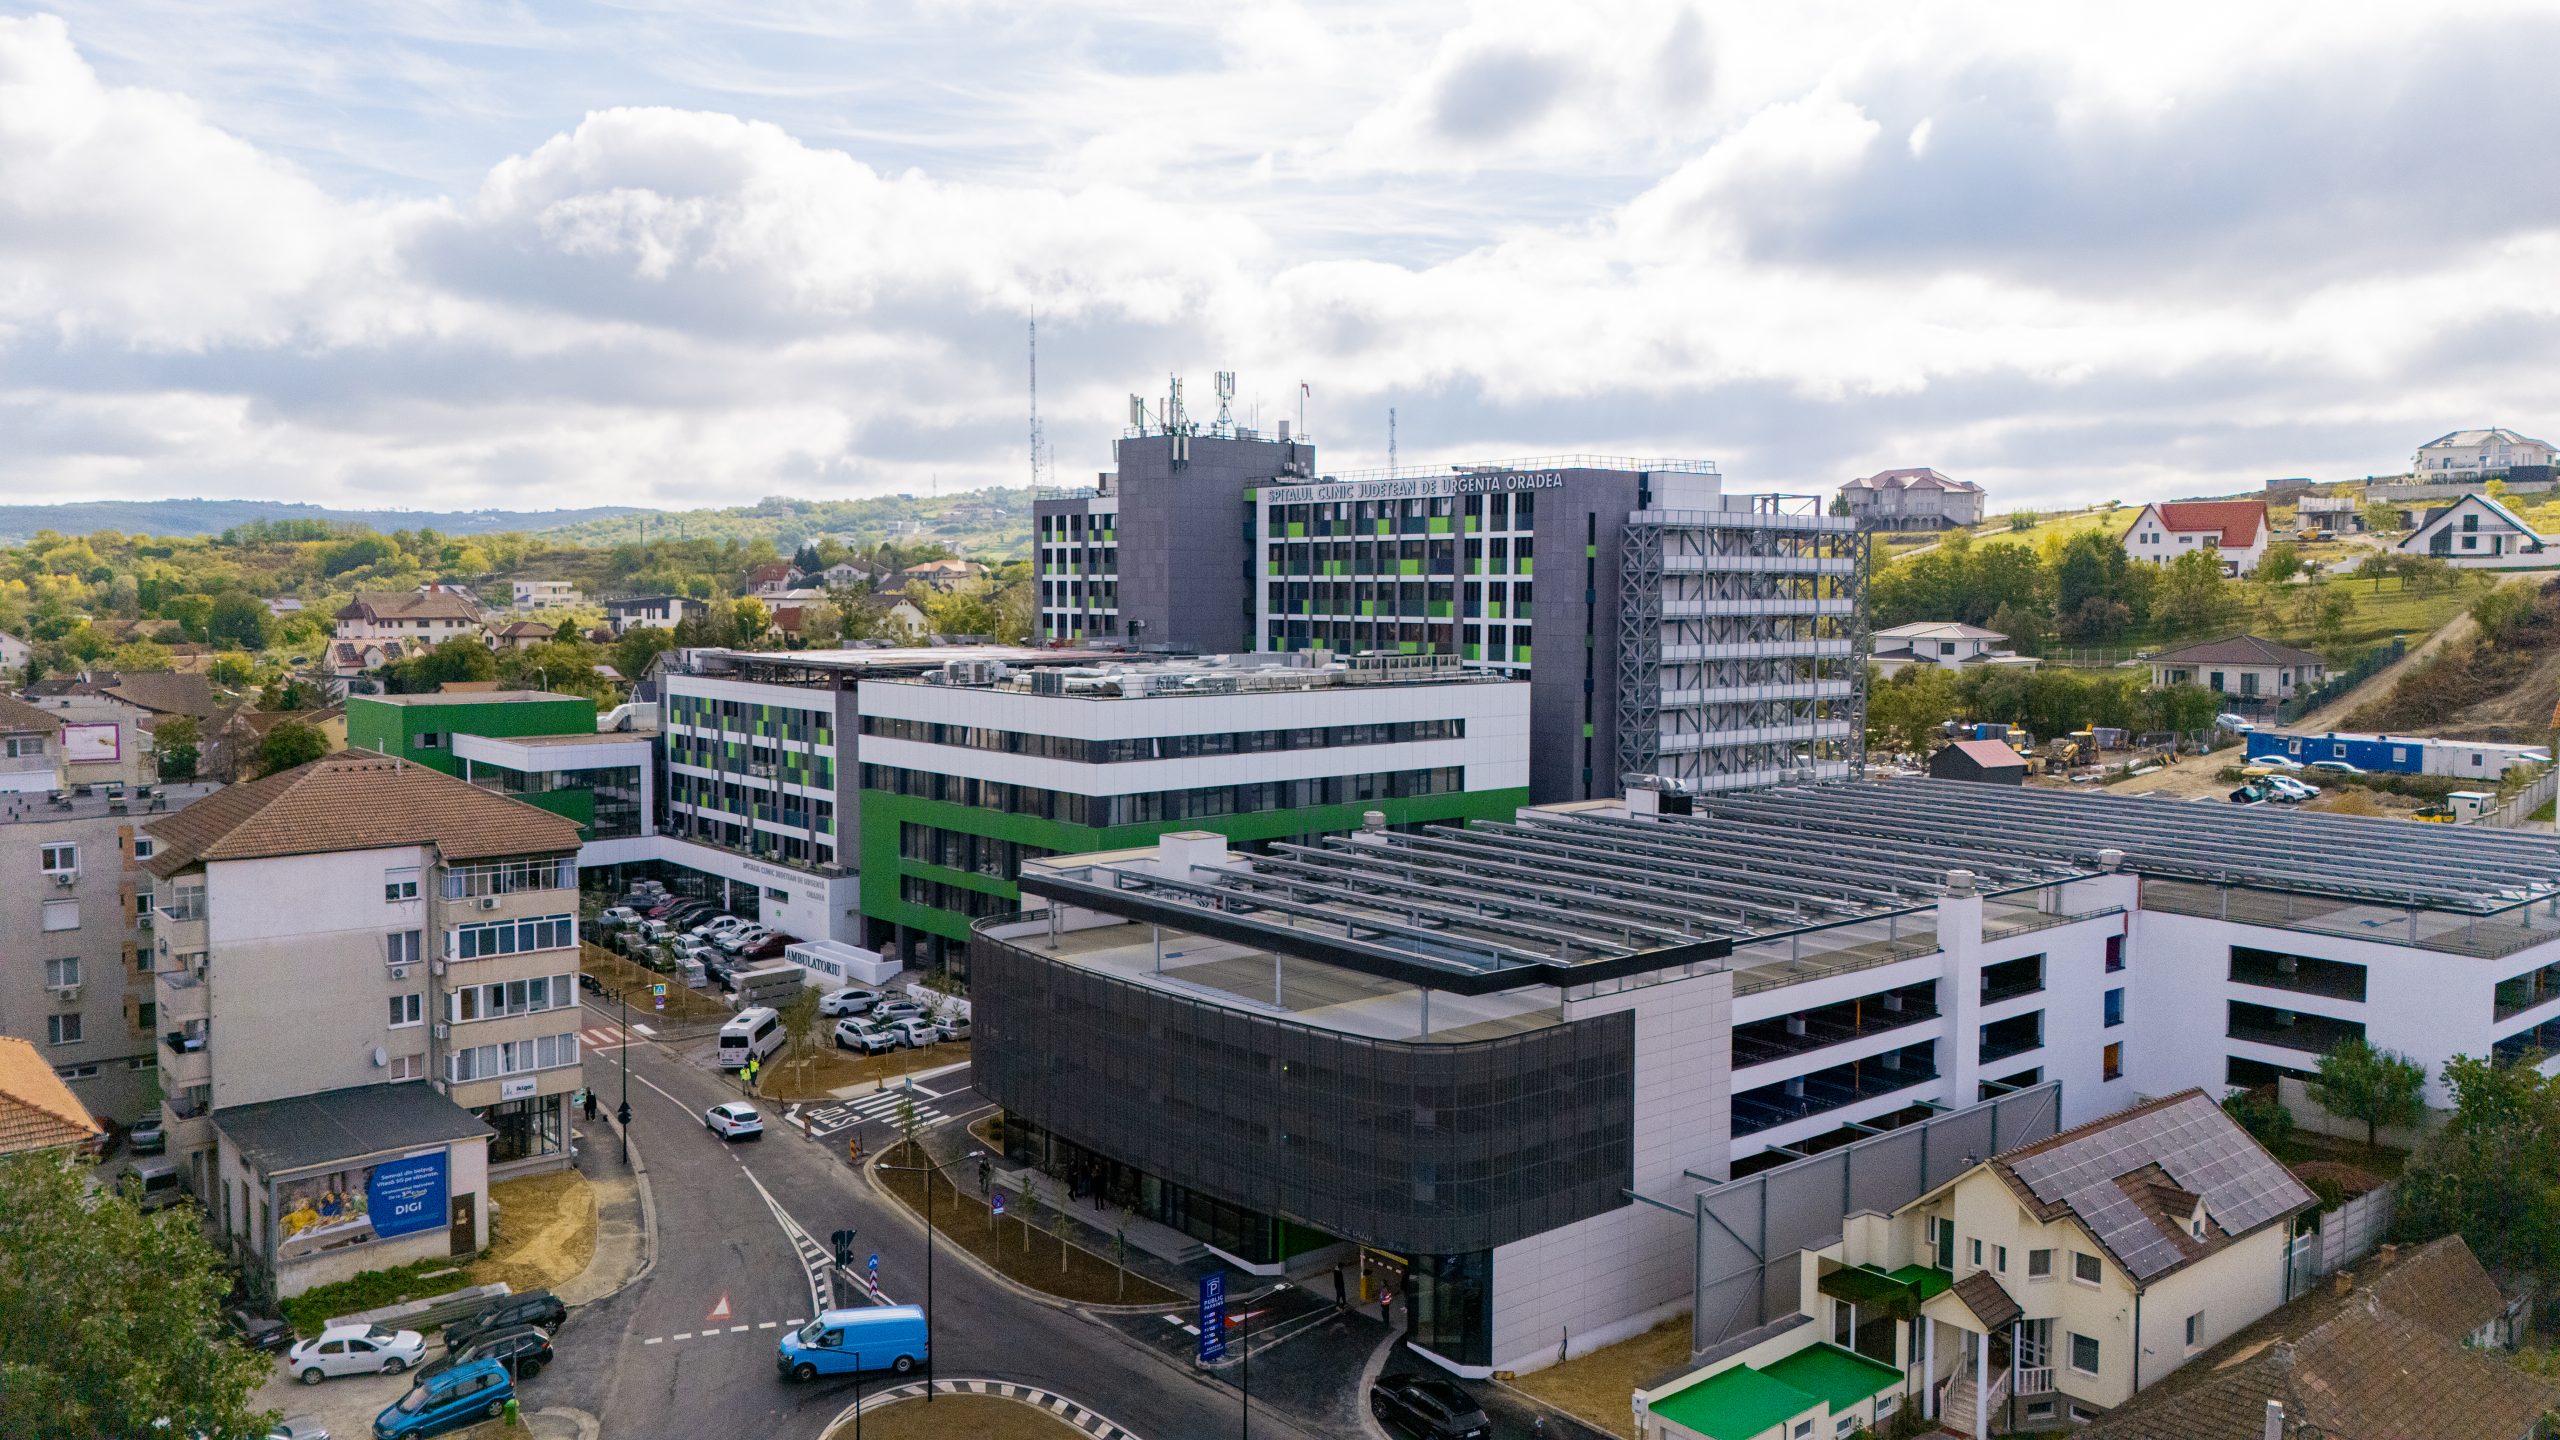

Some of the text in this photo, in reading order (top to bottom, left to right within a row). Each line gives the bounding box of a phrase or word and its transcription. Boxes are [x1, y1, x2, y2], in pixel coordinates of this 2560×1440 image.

[1268, 487, 1313, 502] SPITALUL
[1318, 484, 1354, 499] CLINIC
[1421, 480, 1437, 494] DE
[1442, 476, 1500, 493] URGENTA
[1506, 473, 1563, 490] ORADEA
[786, 949, 840, 976] AMBULATORIU
[805, 1106, 861, 1128] STOP
[395, 1201, 422, 1216] DIGI
[1203, 1295, 1224, 1306] PUBLIC
